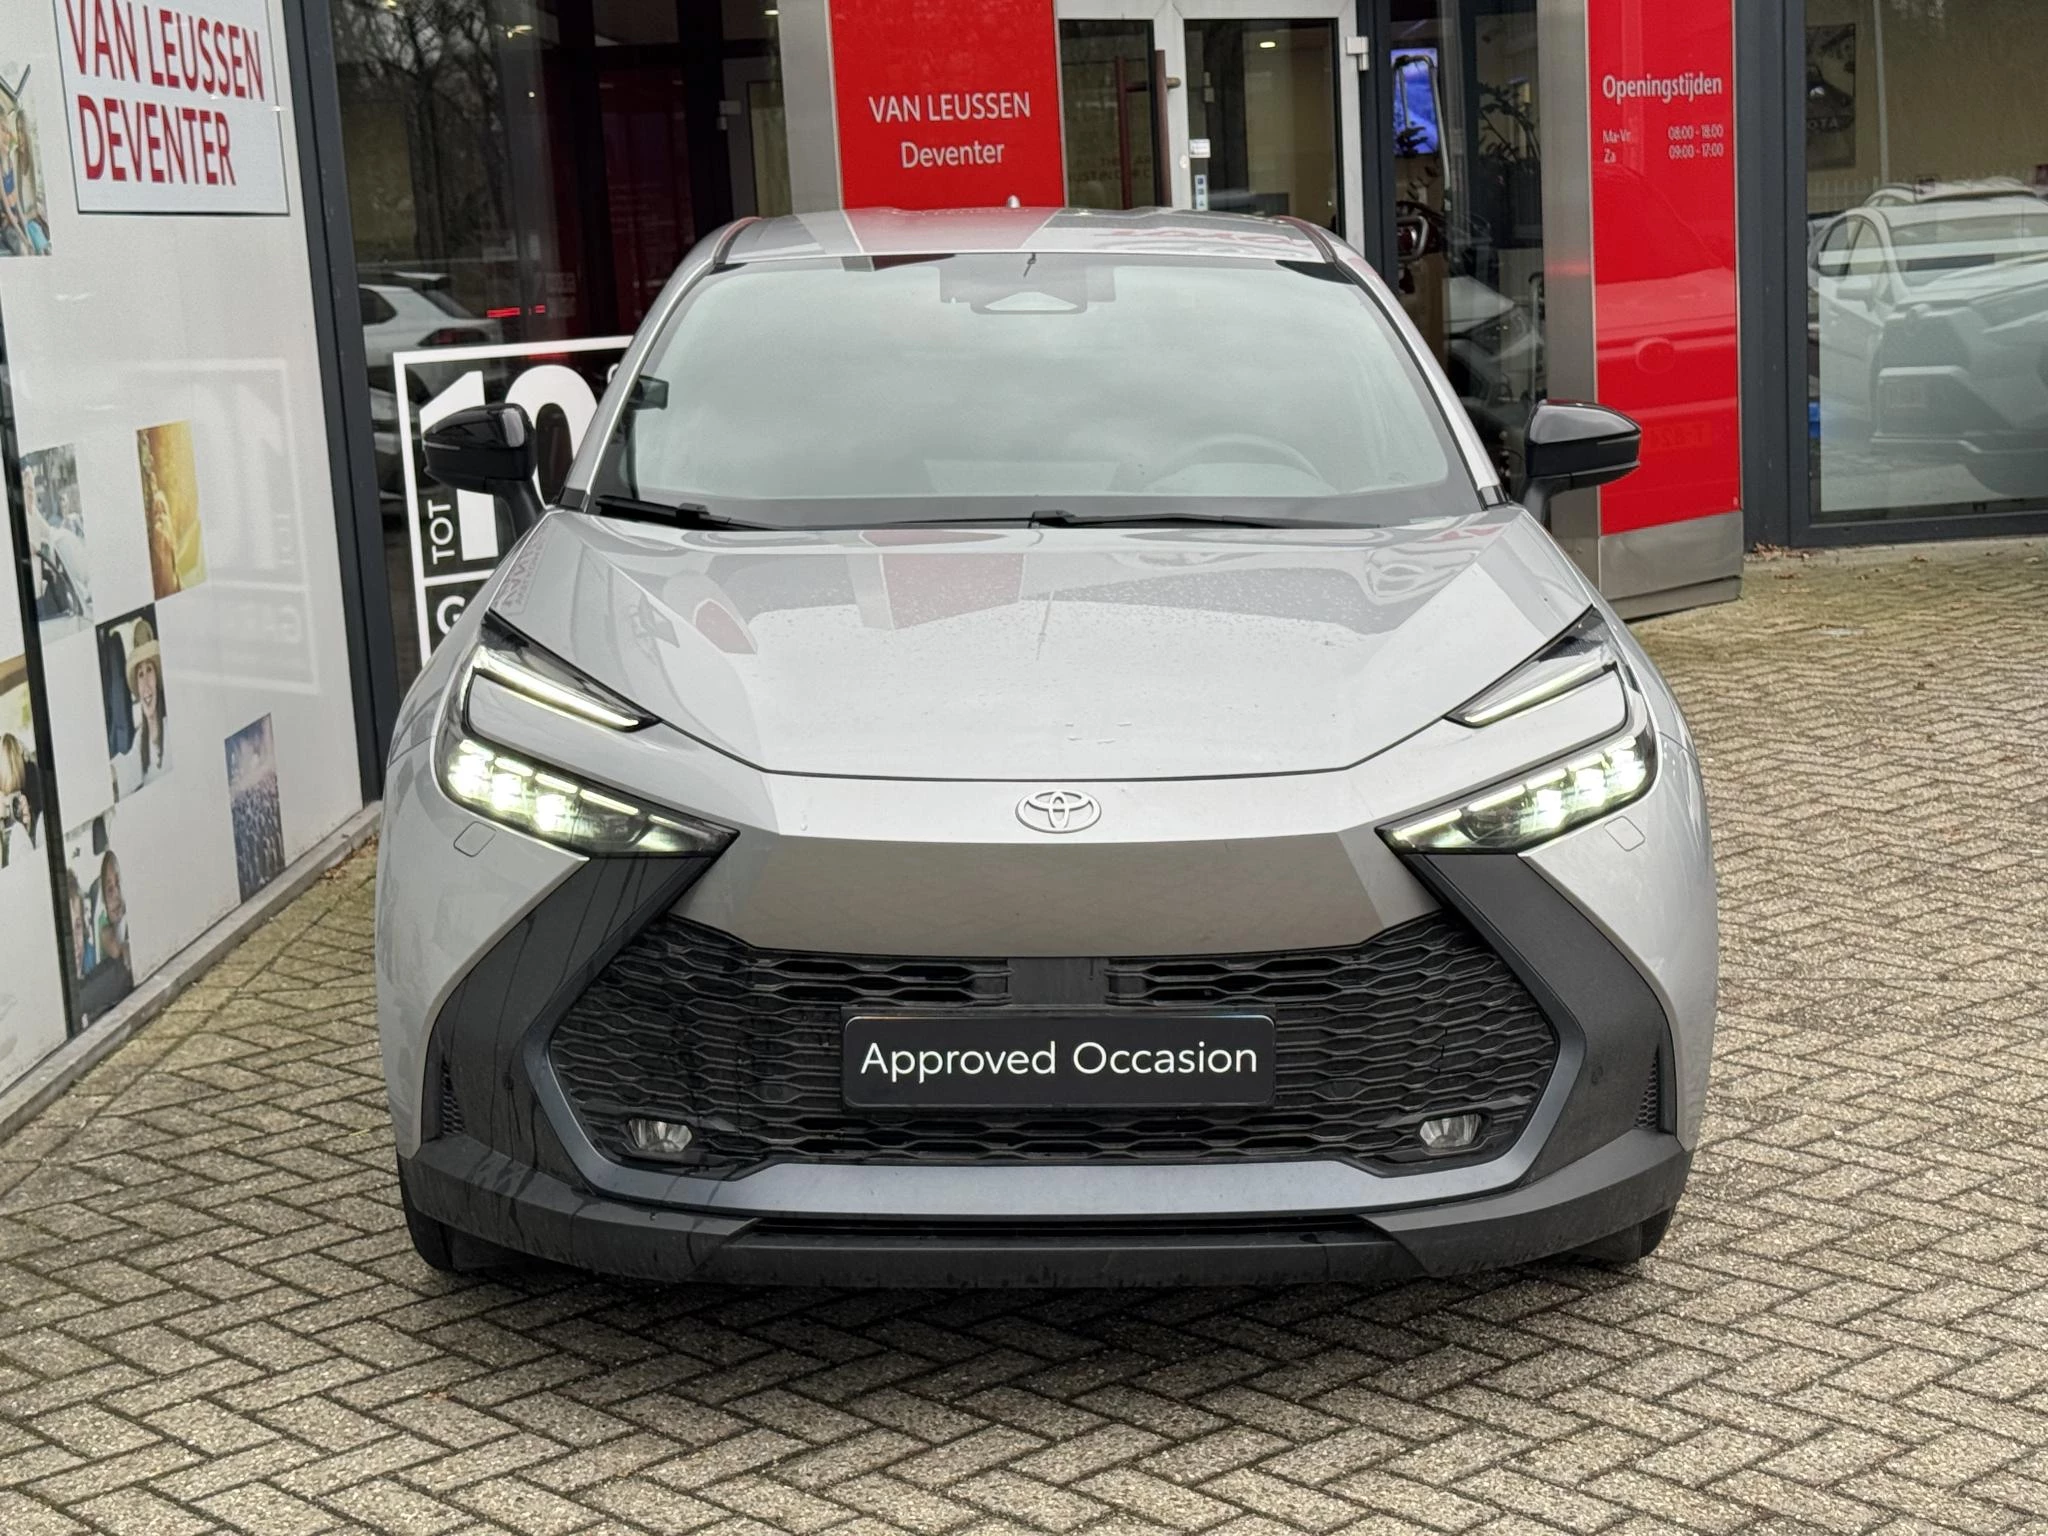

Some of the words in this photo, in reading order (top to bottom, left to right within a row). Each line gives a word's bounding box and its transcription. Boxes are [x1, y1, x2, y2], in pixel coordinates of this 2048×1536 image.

[65, 0, 140, 83] VAN
[143, 5, 265, 101] LEUSSEN
[868, 95, 921, 123] VAN
[927, 92, 1031, 122] LEUSSEN
[1602, 71, 1722, 105] Openingstijden
[77, 94, 236, 186] DEVENTER
[901, 140, 1005, 168] Deventer
[428, 500, 455, 564] TOT
[860, 1041, 1057, 1084] Approved
[1073, 1042, 1258, 1075] Occasion
